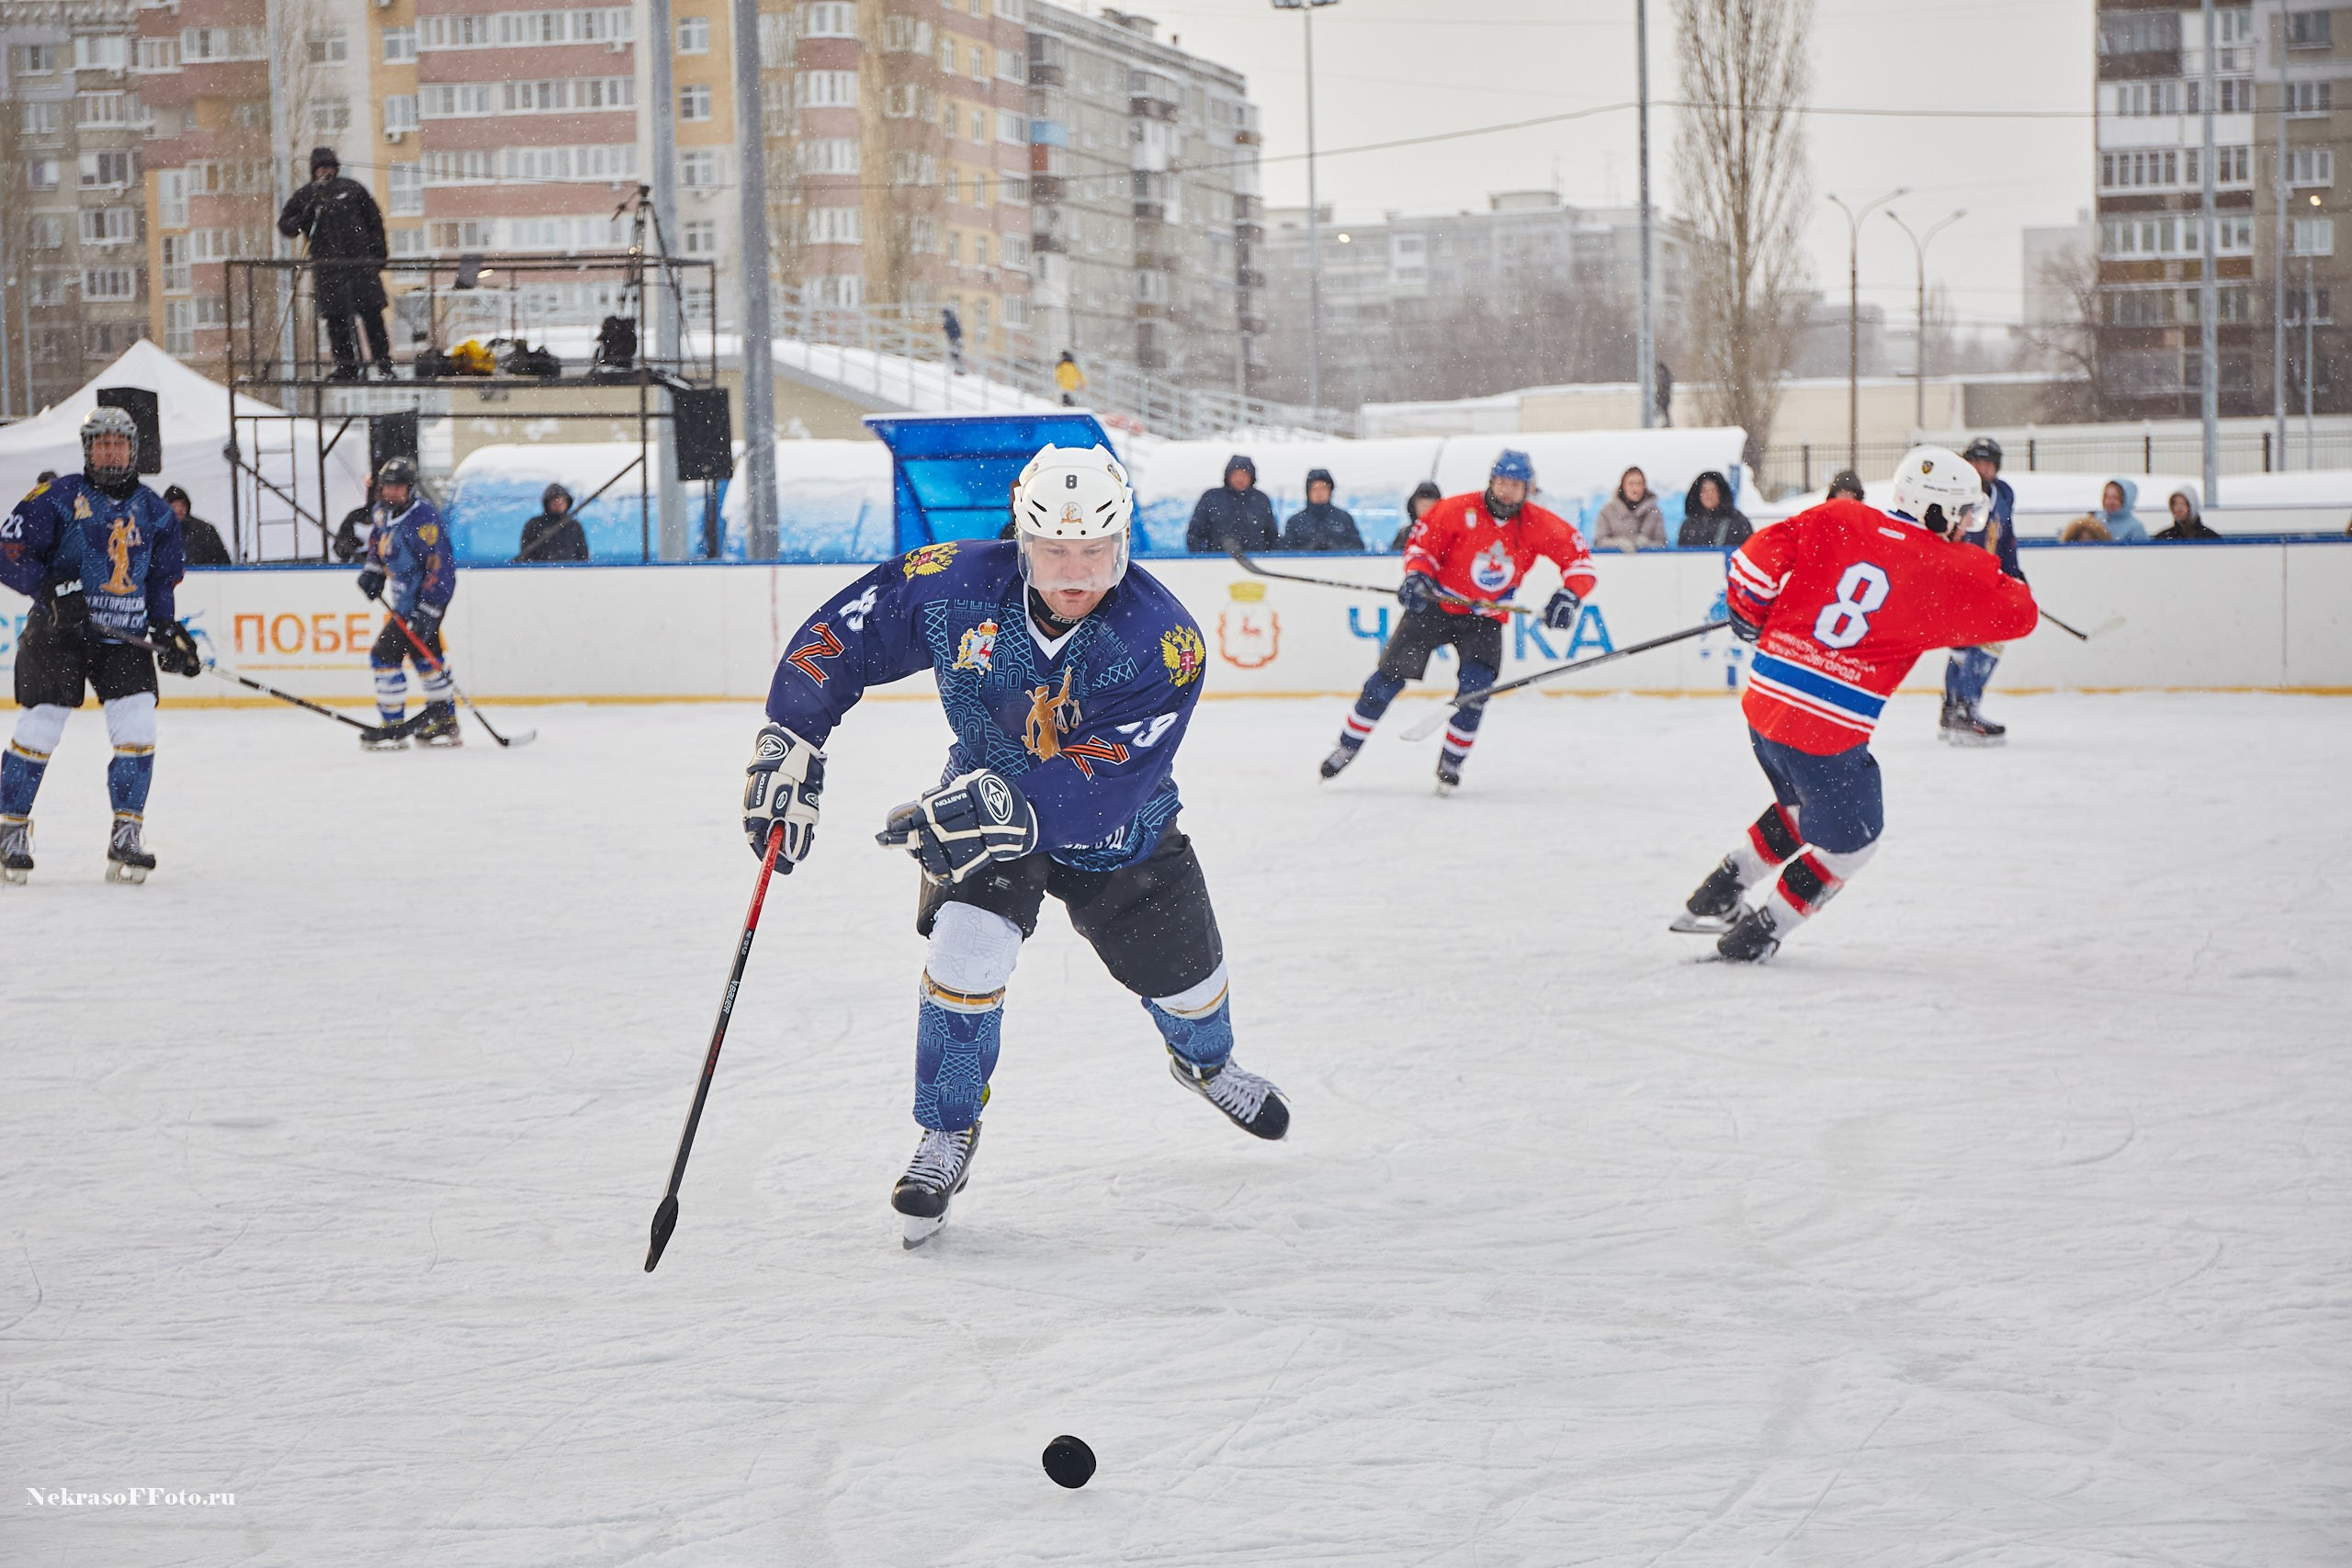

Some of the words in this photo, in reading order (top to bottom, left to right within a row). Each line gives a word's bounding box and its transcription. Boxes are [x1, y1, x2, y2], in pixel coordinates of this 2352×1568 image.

[1065, 474, 1078, 489] 8
[1813, 560, 1892, 649] 8
[233, 612, 448, 656] ПОБЕ
[1348, 604, 1615, 661] ЧКА
[755, 773, 767, 806] EASTON
[934, 792, 967, 807] EASTON
[723, 985, 737, 1014] BAUER
